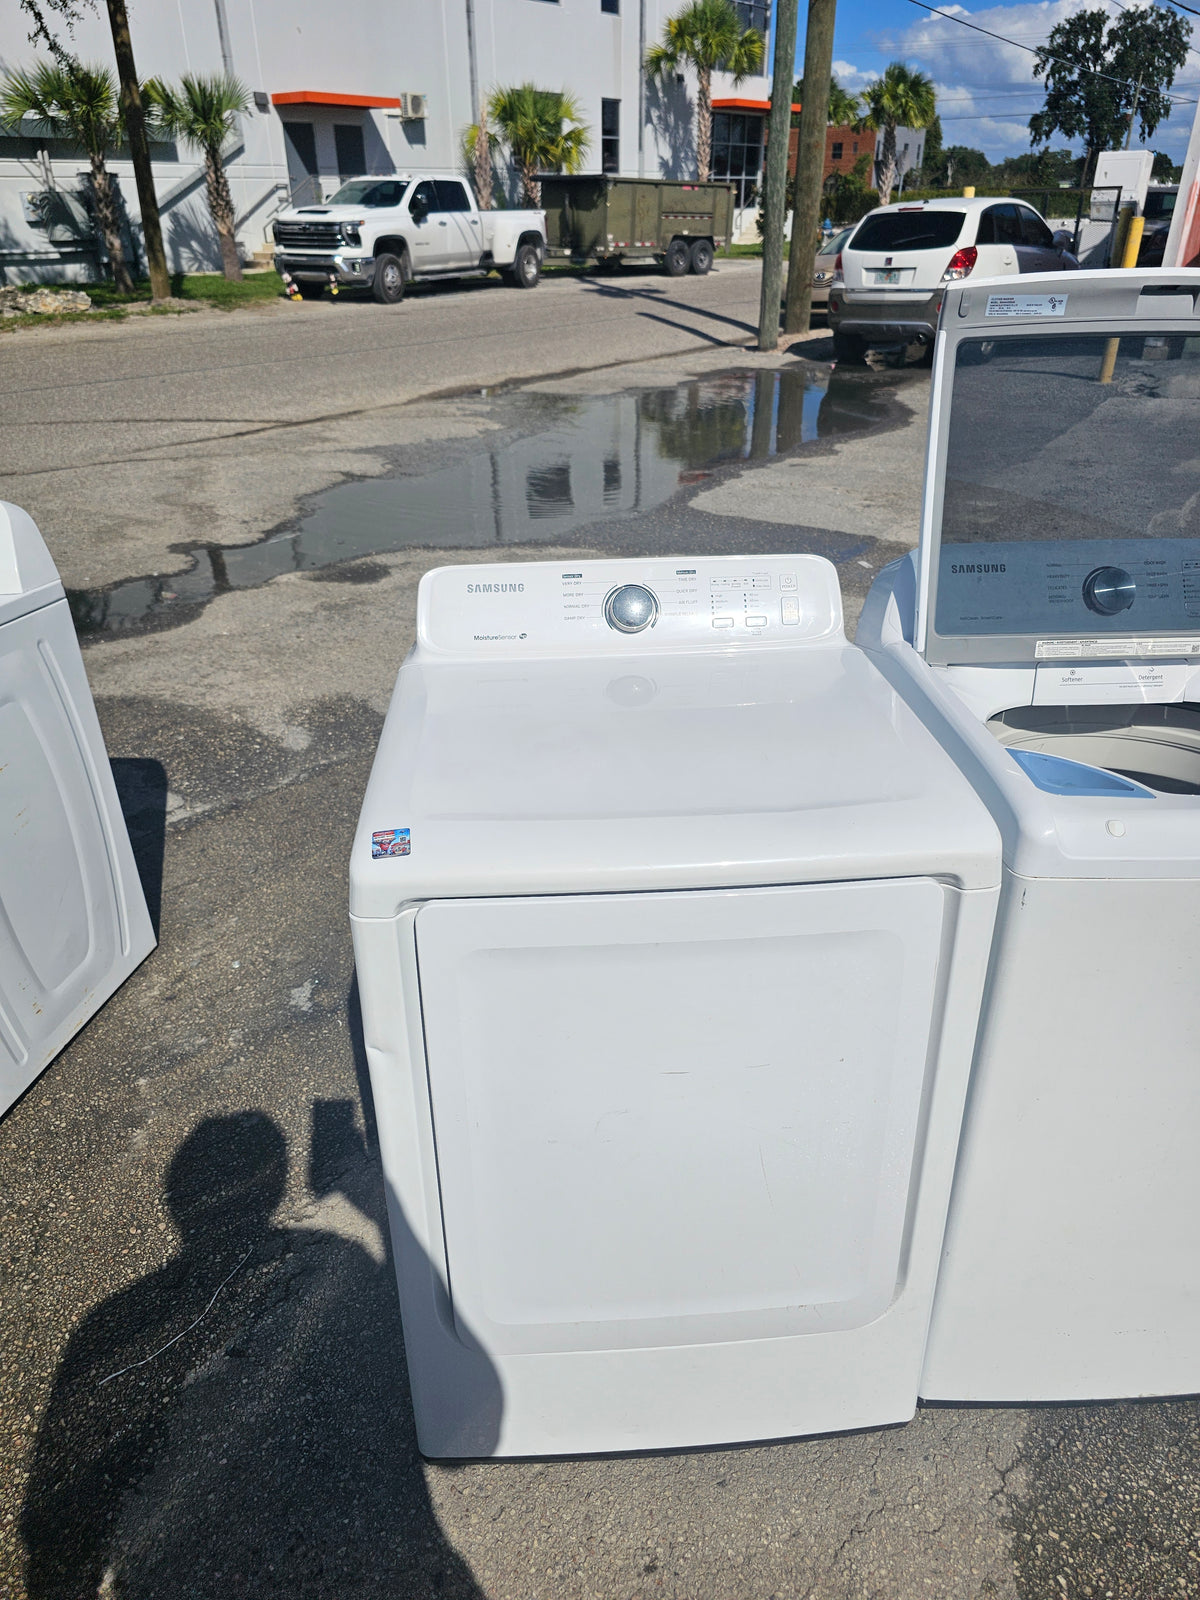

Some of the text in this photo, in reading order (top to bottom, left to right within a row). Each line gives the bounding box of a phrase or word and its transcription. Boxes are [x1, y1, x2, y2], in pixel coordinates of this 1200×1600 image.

[951, 564, 1006, 574] SAMSUNG
[467, 583, 525, 593] SAMSUNG
[1138, 674, 1163, 682] Detergent
